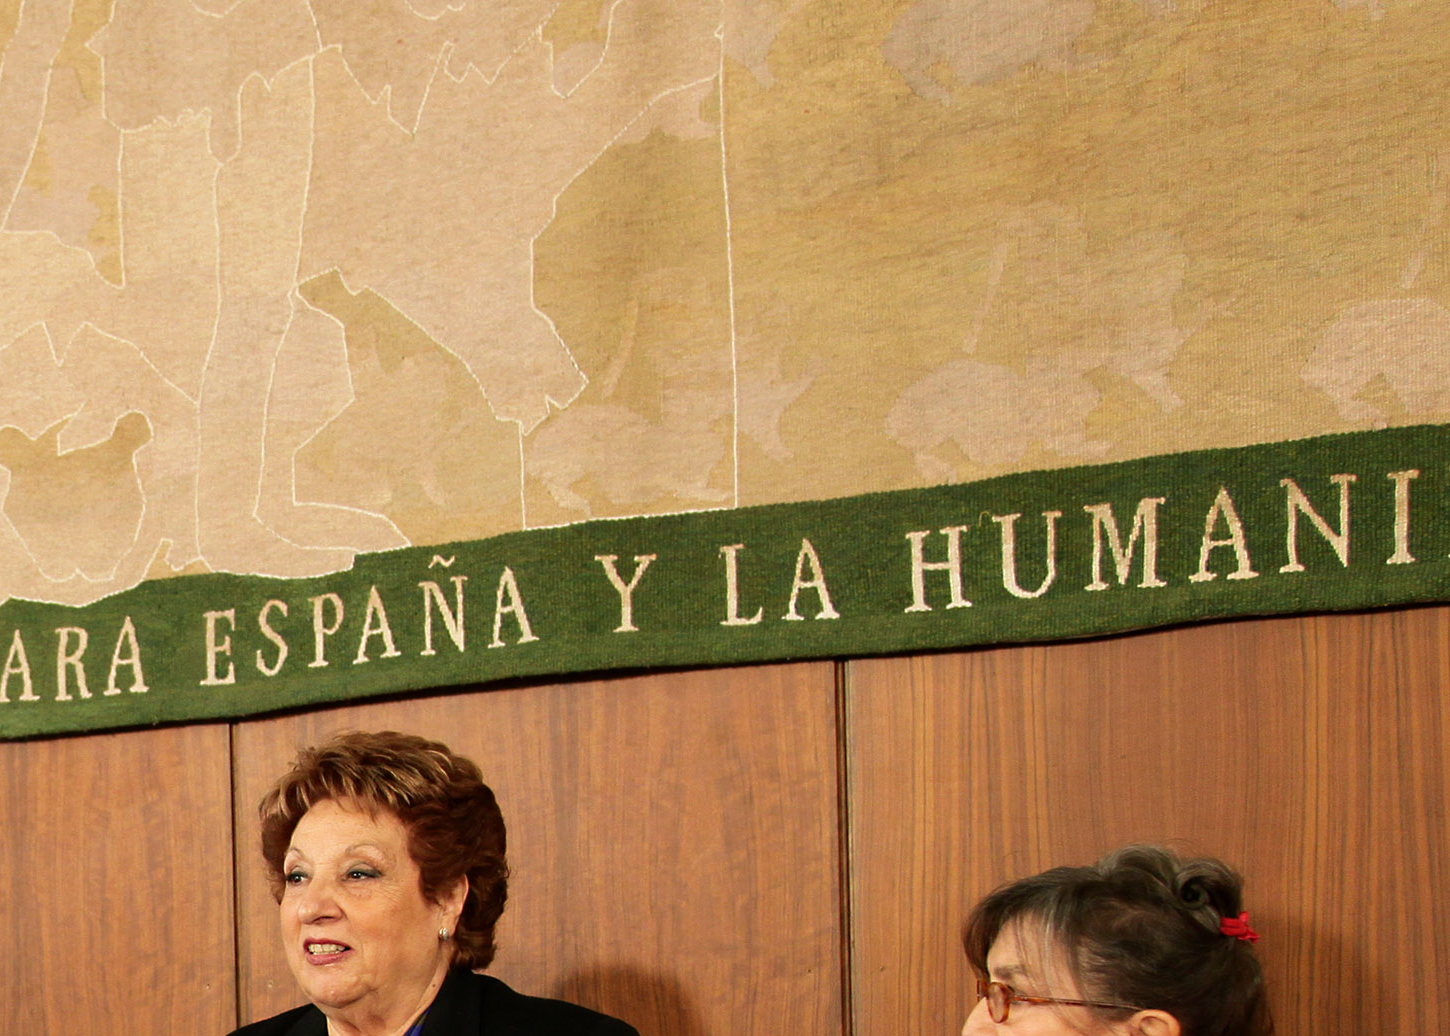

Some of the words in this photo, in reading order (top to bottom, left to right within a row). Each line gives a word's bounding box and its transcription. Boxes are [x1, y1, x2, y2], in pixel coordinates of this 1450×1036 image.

[200, 555, 539, 686] ESPAÑA
[595, 554, 656, 633] Y
[719, 538, 840, 626] LA
